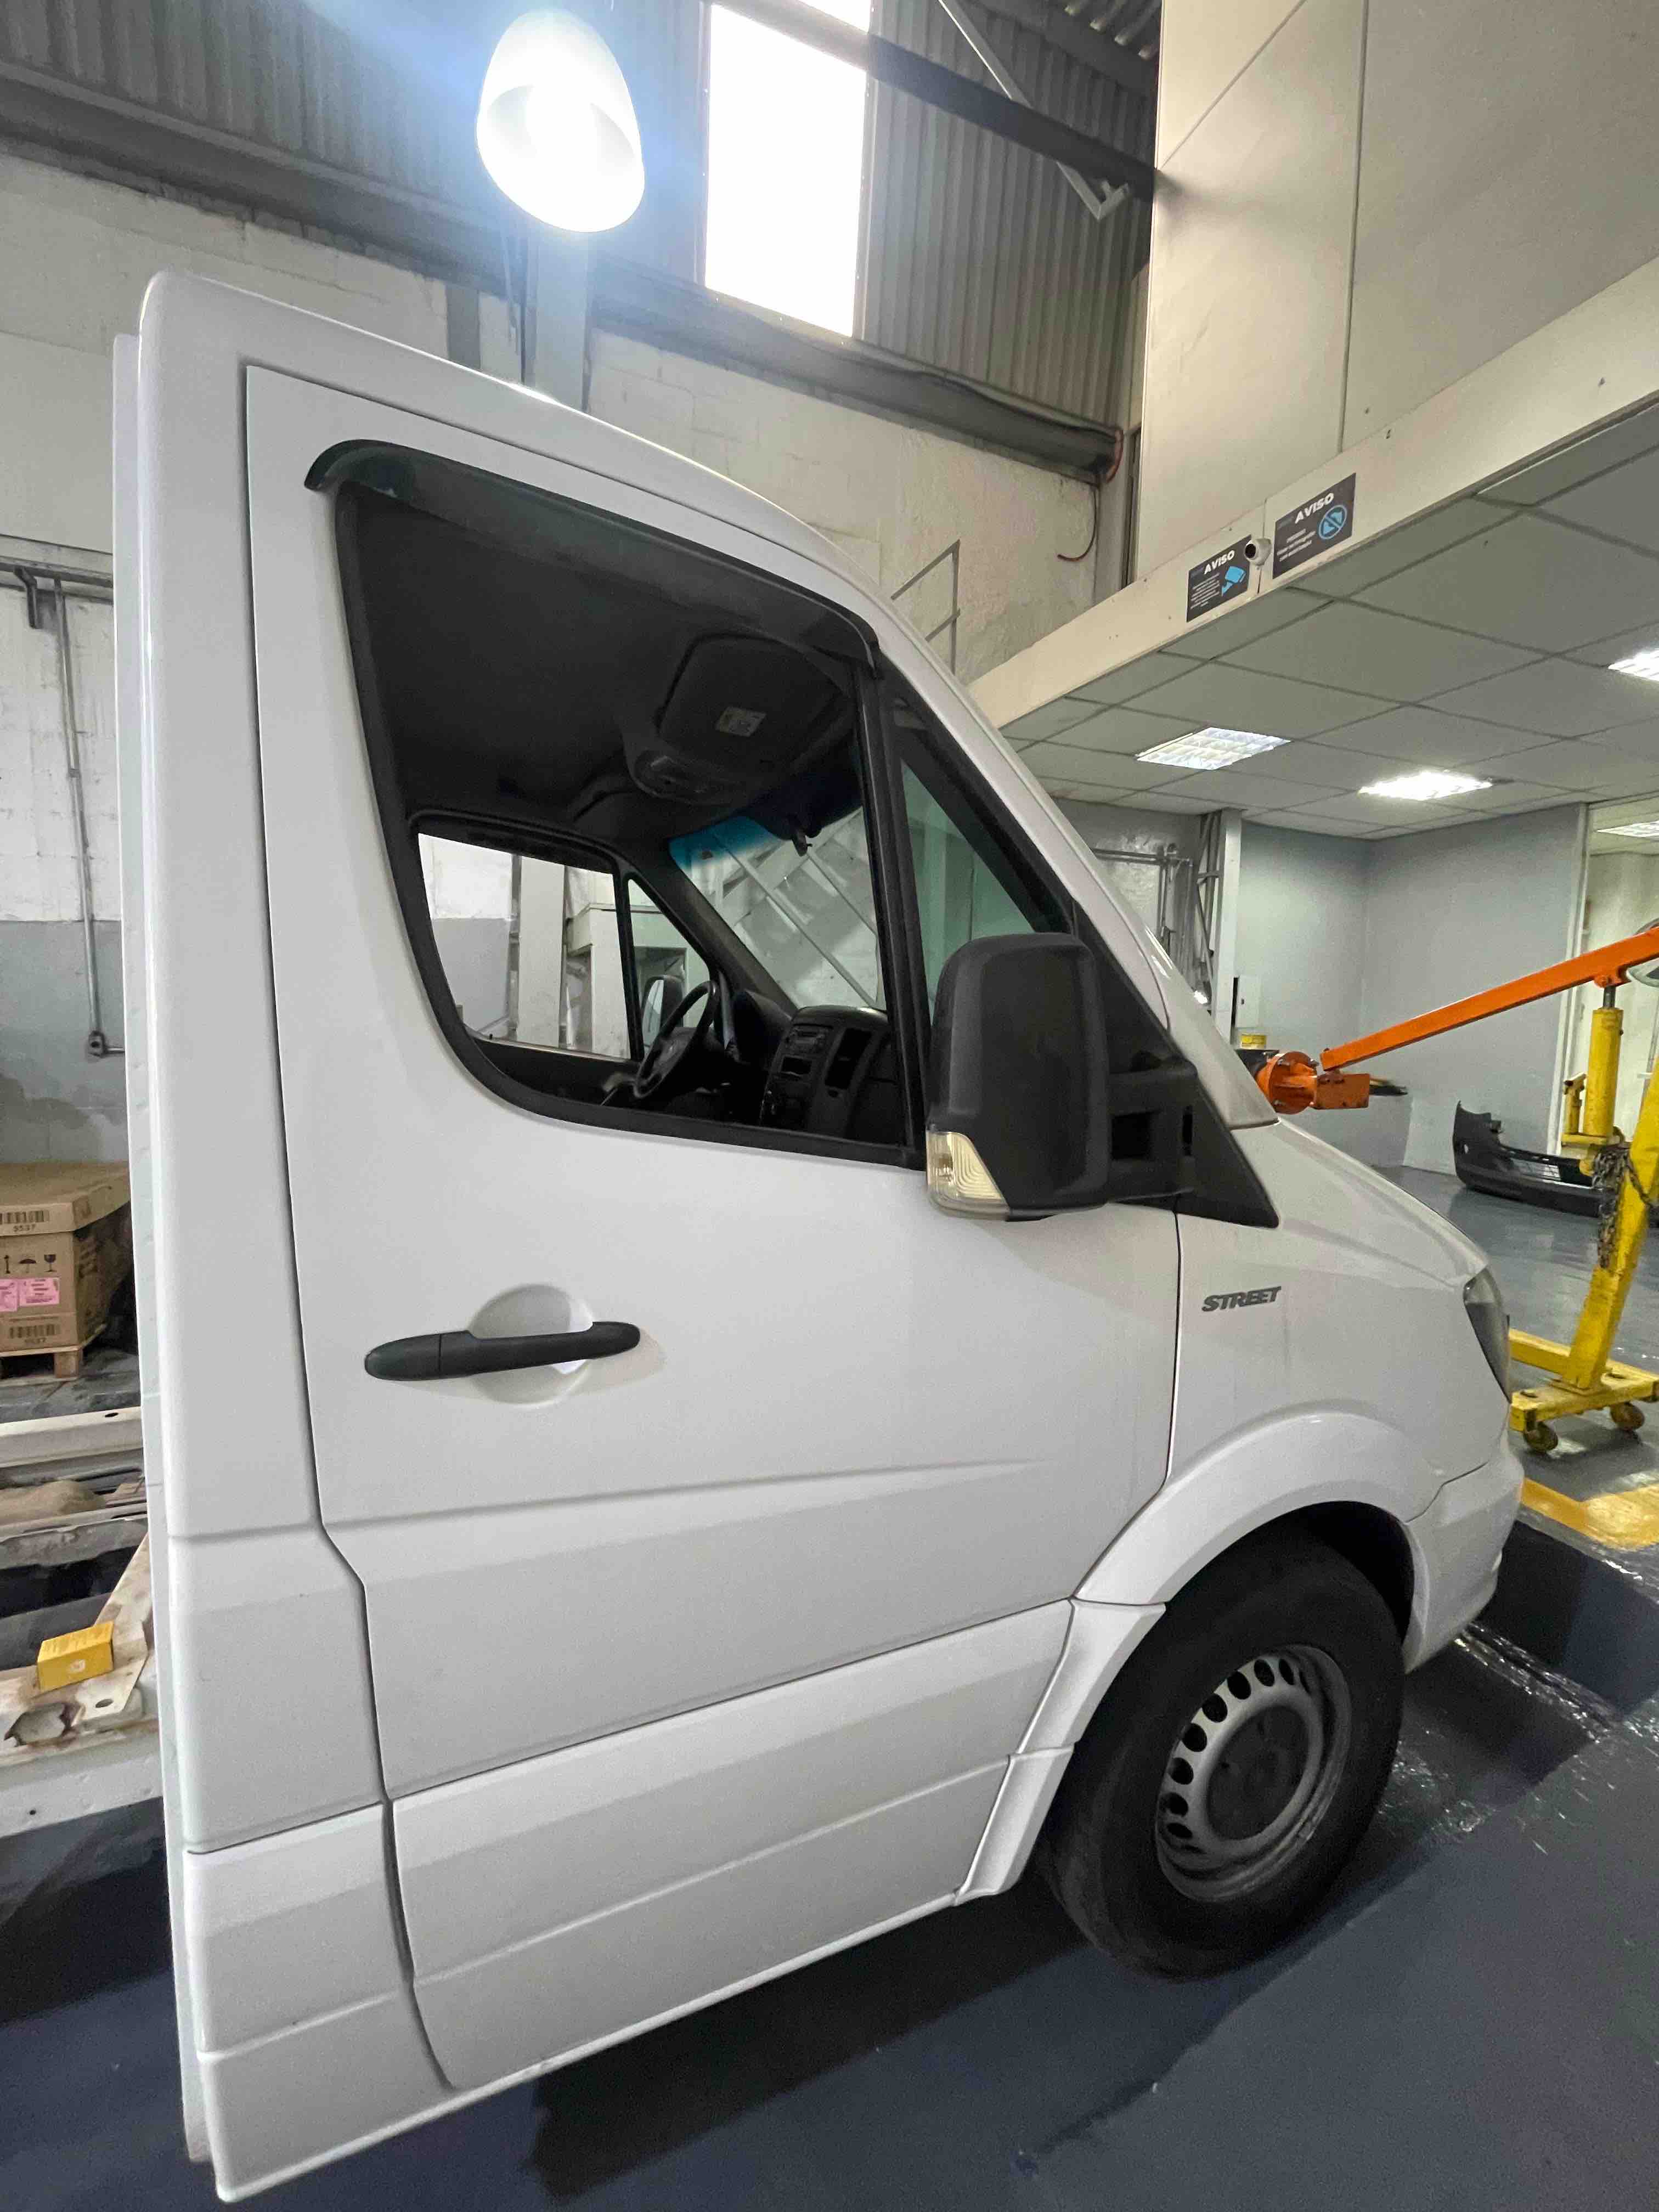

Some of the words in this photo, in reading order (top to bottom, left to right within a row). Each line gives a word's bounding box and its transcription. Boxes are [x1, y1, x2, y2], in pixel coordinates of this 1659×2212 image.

[1295, 493, 1334, 524] AVISO
[1204, 550, 1235, 575] AVISO
[1201, 1286, 1282, 1312] STREET
